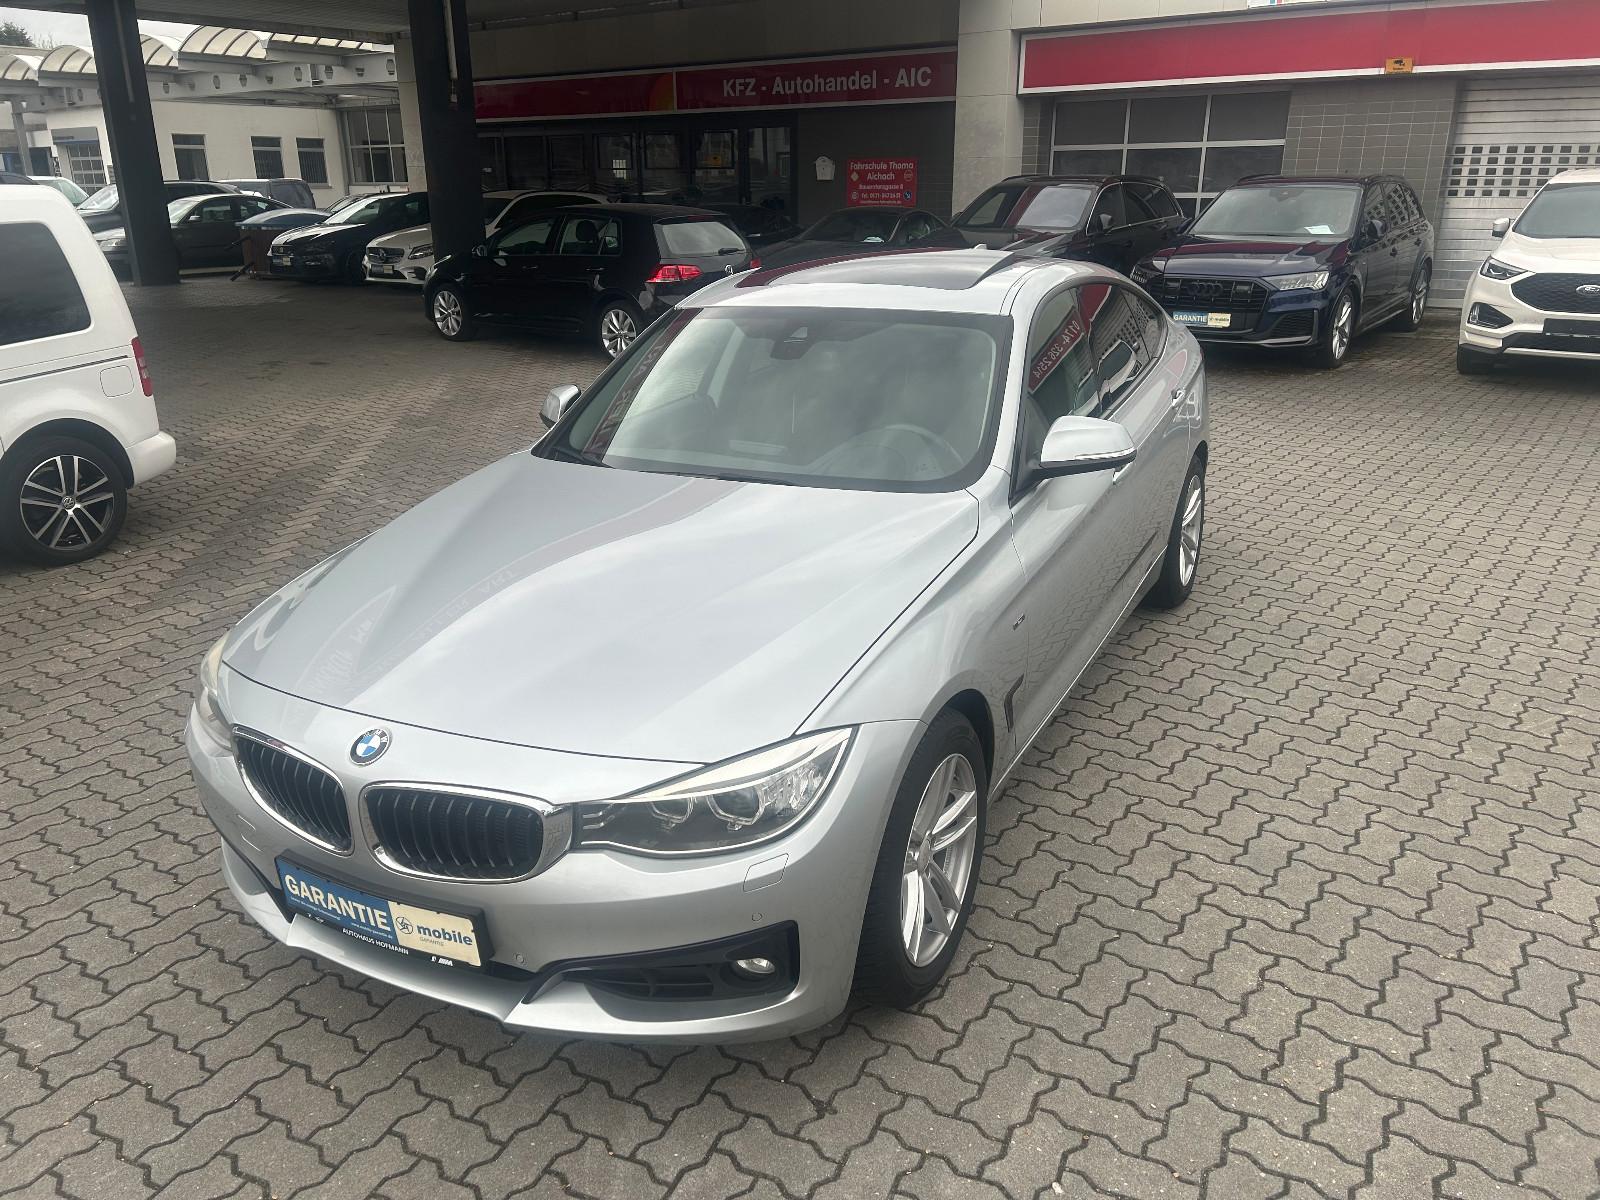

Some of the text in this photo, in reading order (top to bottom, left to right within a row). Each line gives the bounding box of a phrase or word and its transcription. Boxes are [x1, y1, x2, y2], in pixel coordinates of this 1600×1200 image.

[723, 78, 756, 97] KFZ
[772, 70, 877, 95] Autohandel
[895, 66, 932, 88] AIC
[850, 162, 914, 170] Fahrschule Thoma
[867, 172, 895, 181] Aichach
[1173, 314, 1207, 322] GARANTIE
[284, 874, 391, 932] GARANTIE
[416, 924, 473, 946] mobile
